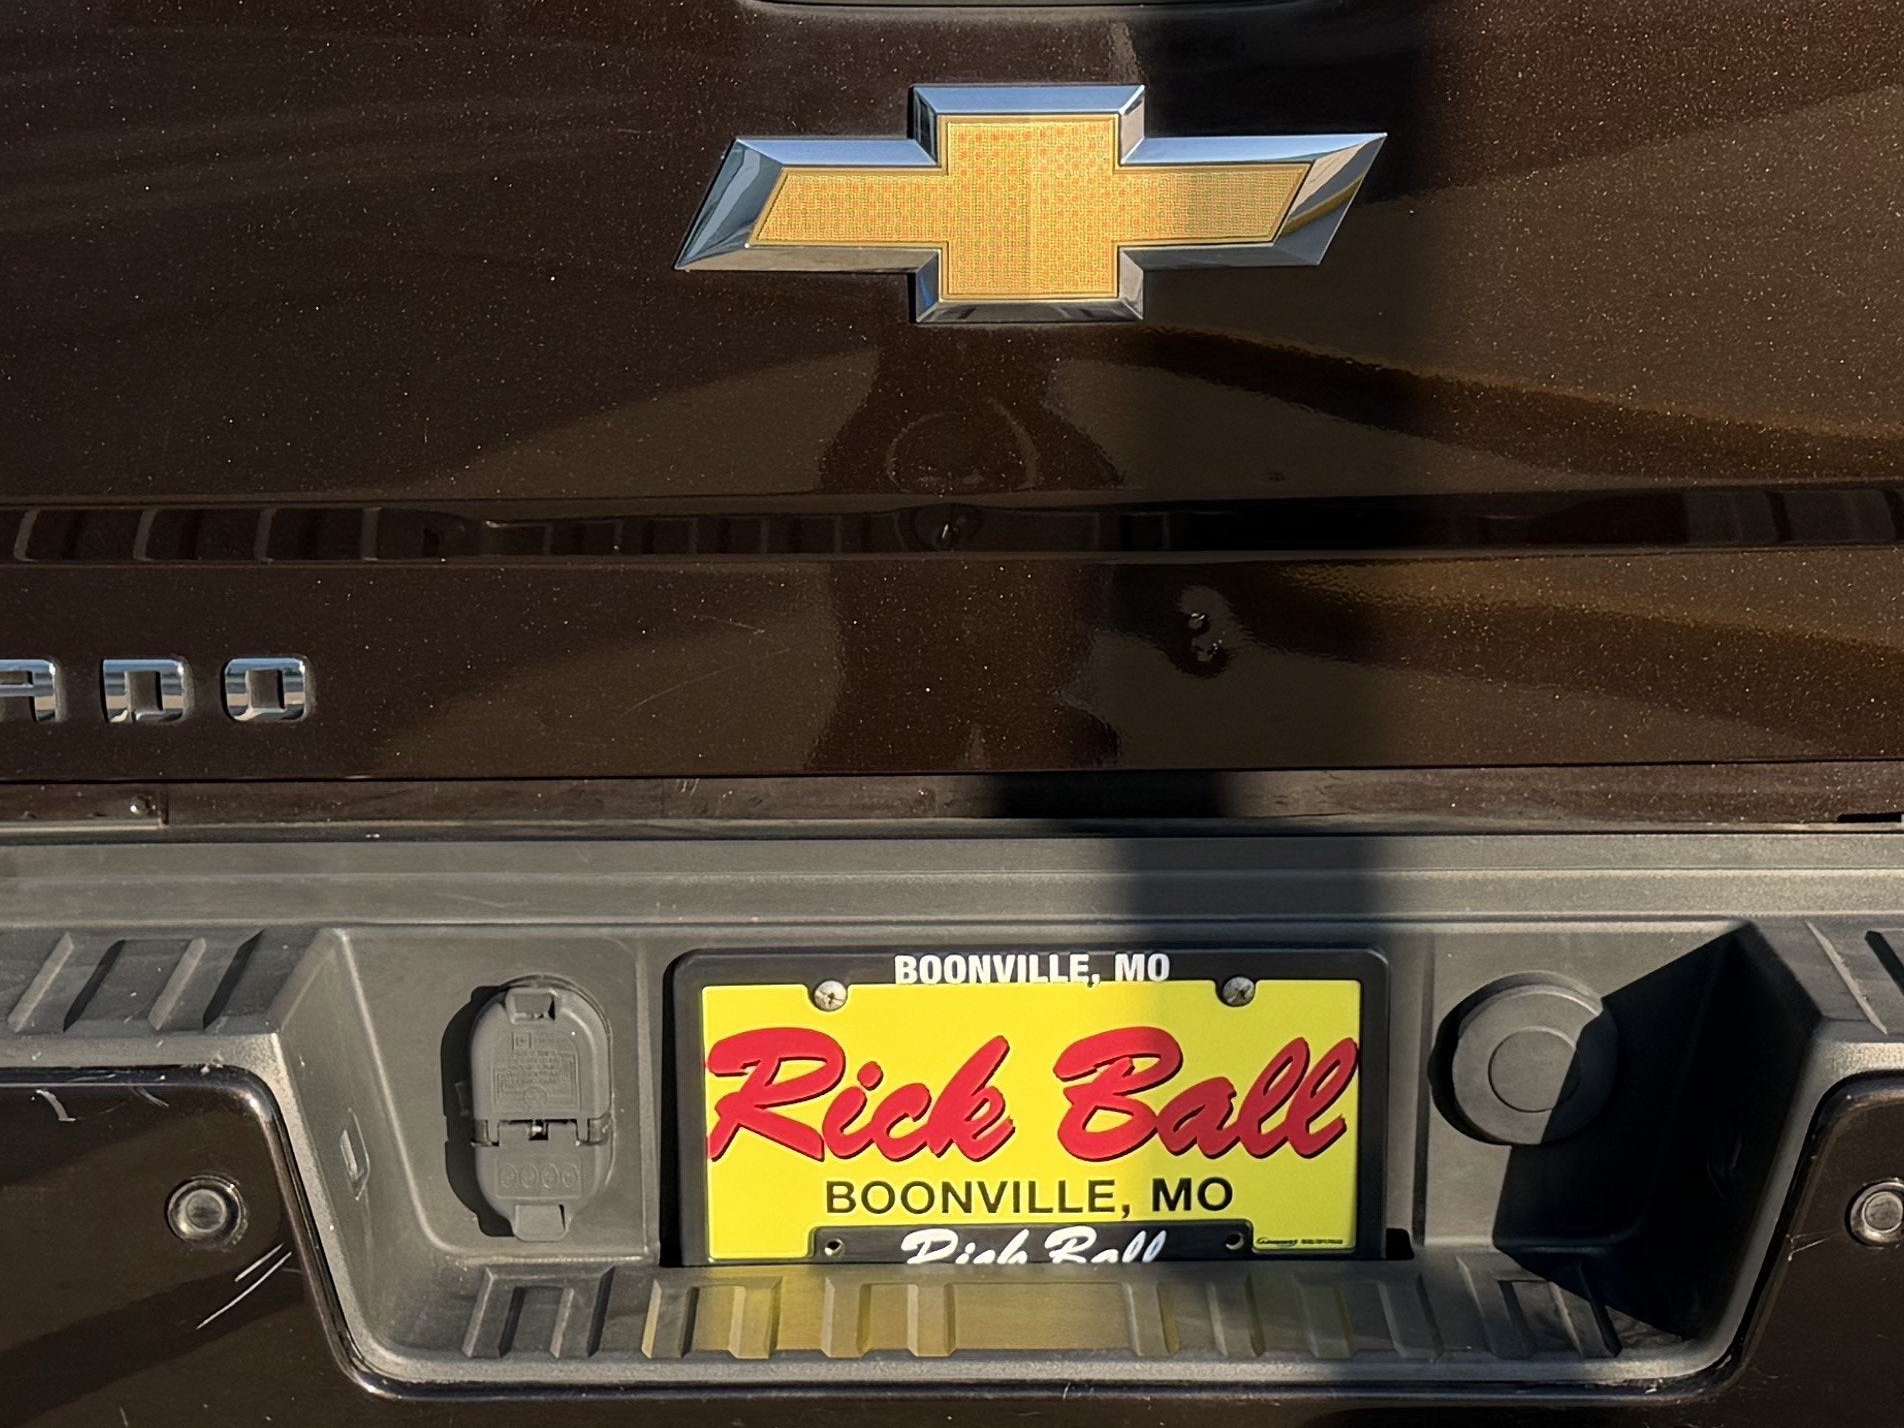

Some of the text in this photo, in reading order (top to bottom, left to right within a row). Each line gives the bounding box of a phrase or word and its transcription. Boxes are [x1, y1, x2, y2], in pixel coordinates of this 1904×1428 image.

[893, 953, 1171, 987] BOONVILLE, MO
[706, 1025, 1361, 1164] Rick Ball
[826, 1176, 1234, 1220] BOONVILLE, MO
